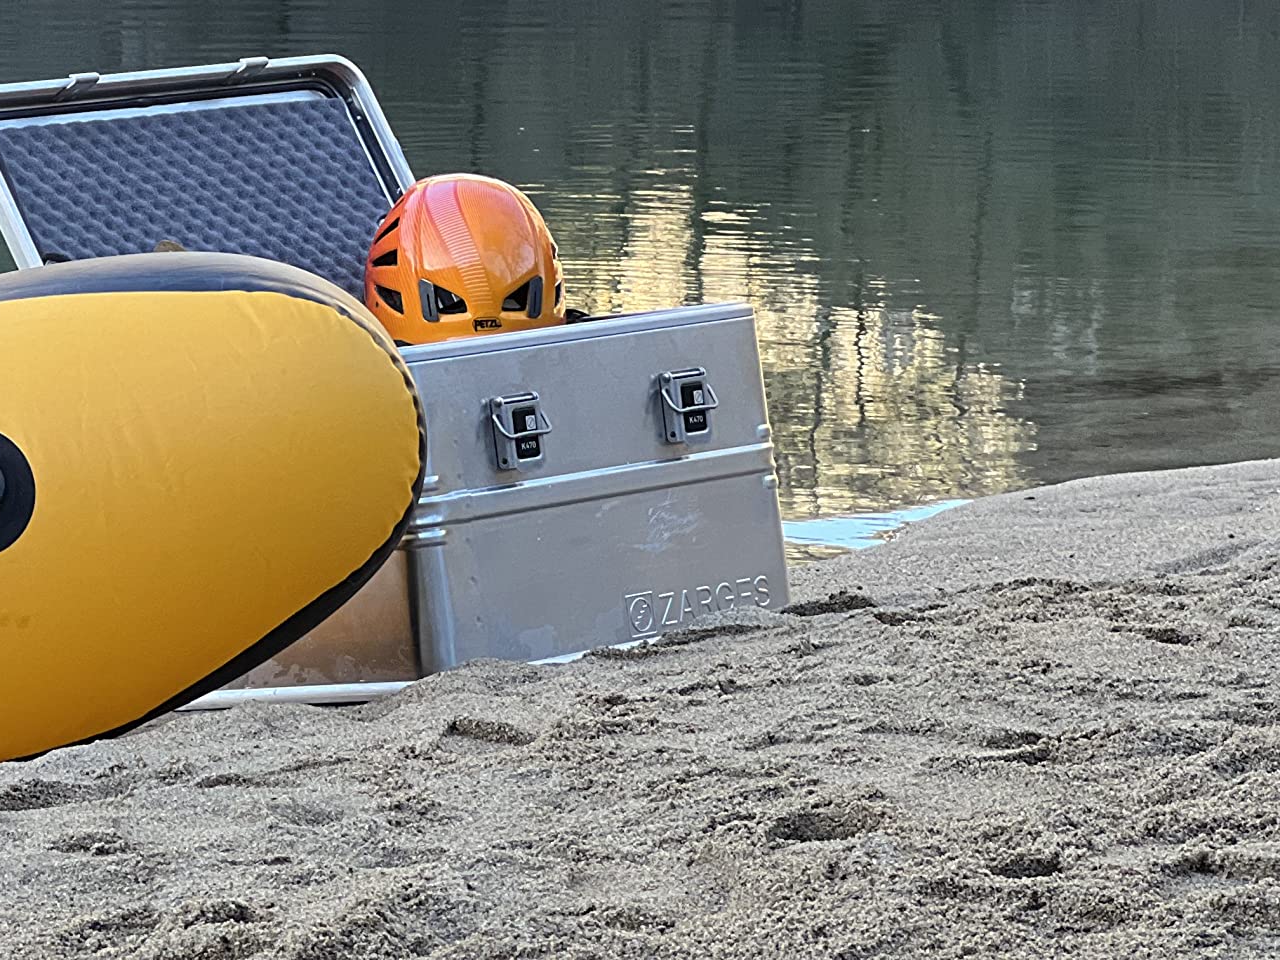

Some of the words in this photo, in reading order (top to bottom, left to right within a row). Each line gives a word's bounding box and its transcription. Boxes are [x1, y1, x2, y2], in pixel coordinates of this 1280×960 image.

[474, 319, 502, 332] PETZL
[688, 415, 704, 424] K470
[520, 440, 537, 450] K470
[658, 575, 770, 625] ZARGES
